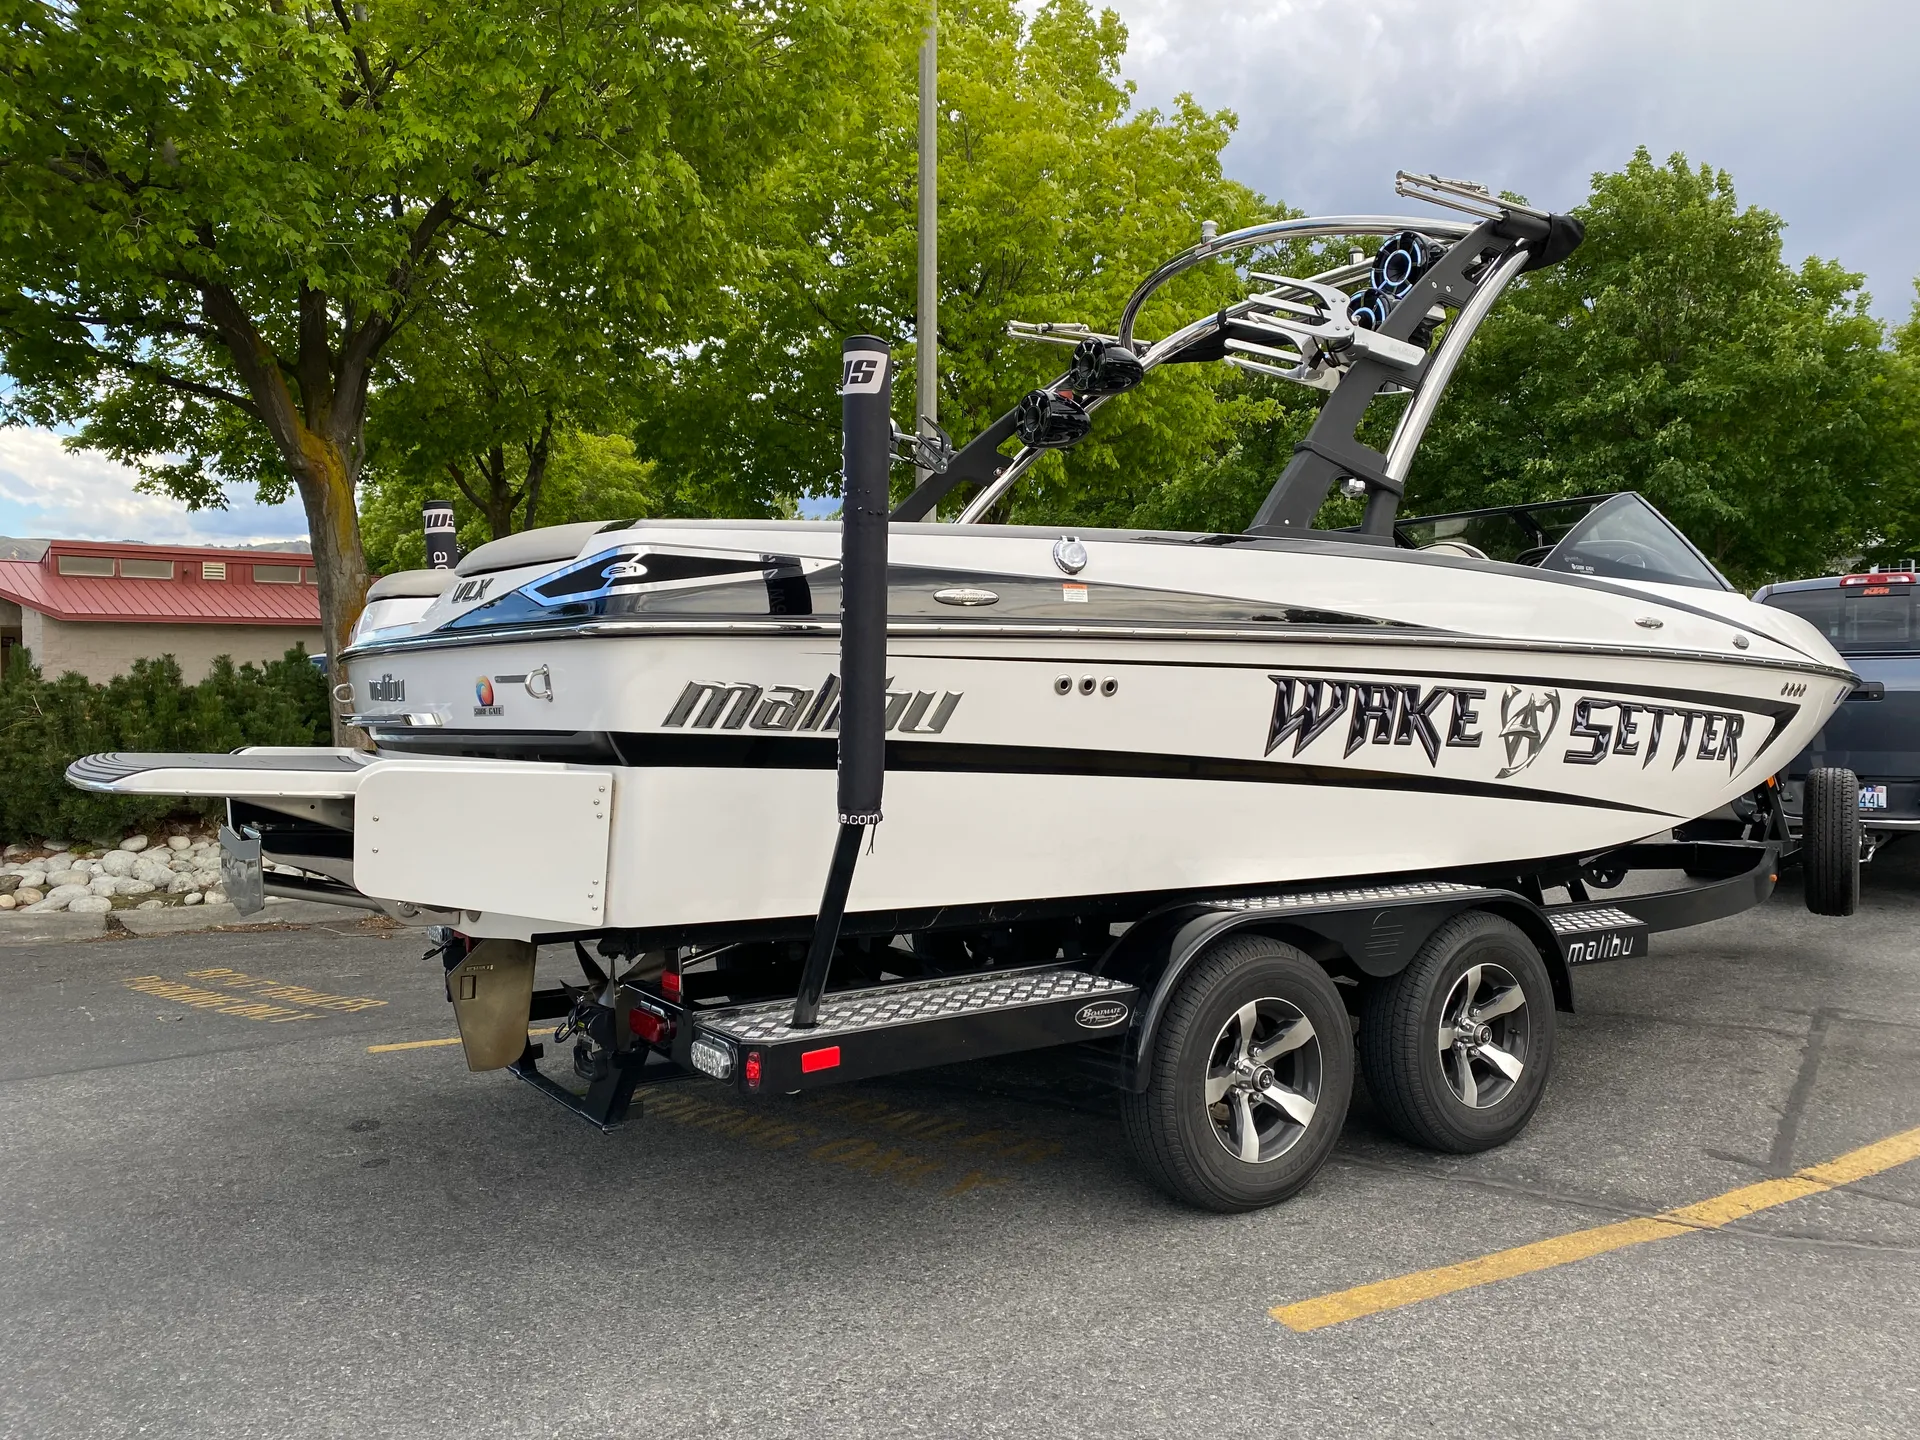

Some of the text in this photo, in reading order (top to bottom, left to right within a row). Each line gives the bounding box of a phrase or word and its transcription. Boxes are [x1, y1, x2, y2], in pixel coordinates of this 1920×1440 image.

[451, 577, 495, 605] VLX
[660, 672, 965, 734] malu
[1264, 674, 1745, 778] WAKE SETTER
[1567, 933, 1634, 963] malibu
[215, 1003, 329, 1023] ONLY
